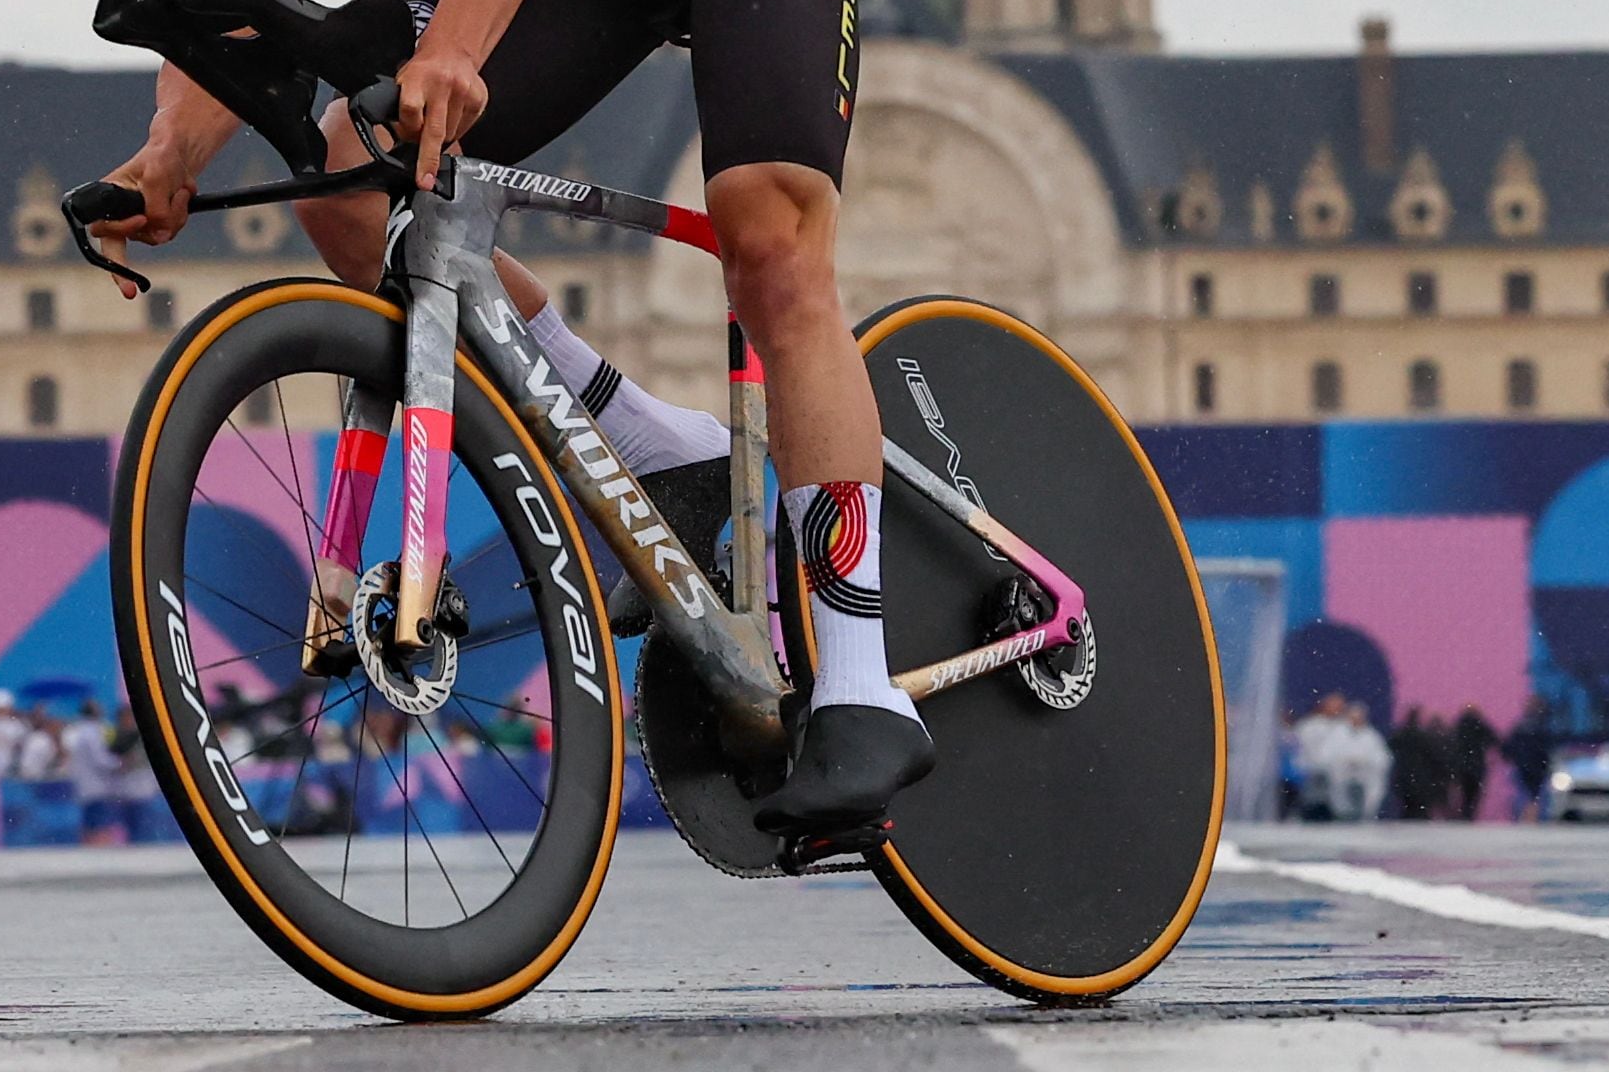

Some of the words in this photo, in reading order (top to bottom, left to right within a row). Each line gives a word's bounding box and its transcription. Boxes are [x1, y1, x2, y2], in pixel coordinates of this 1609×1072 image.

[472, 162, 592, 202] SPECIALIZED
[406, 413, 428, 593] SPECIALIZED
[474, 298, 721, 620] S-WORKS
[925, 629, 1046, 695] SPECIALIZED
